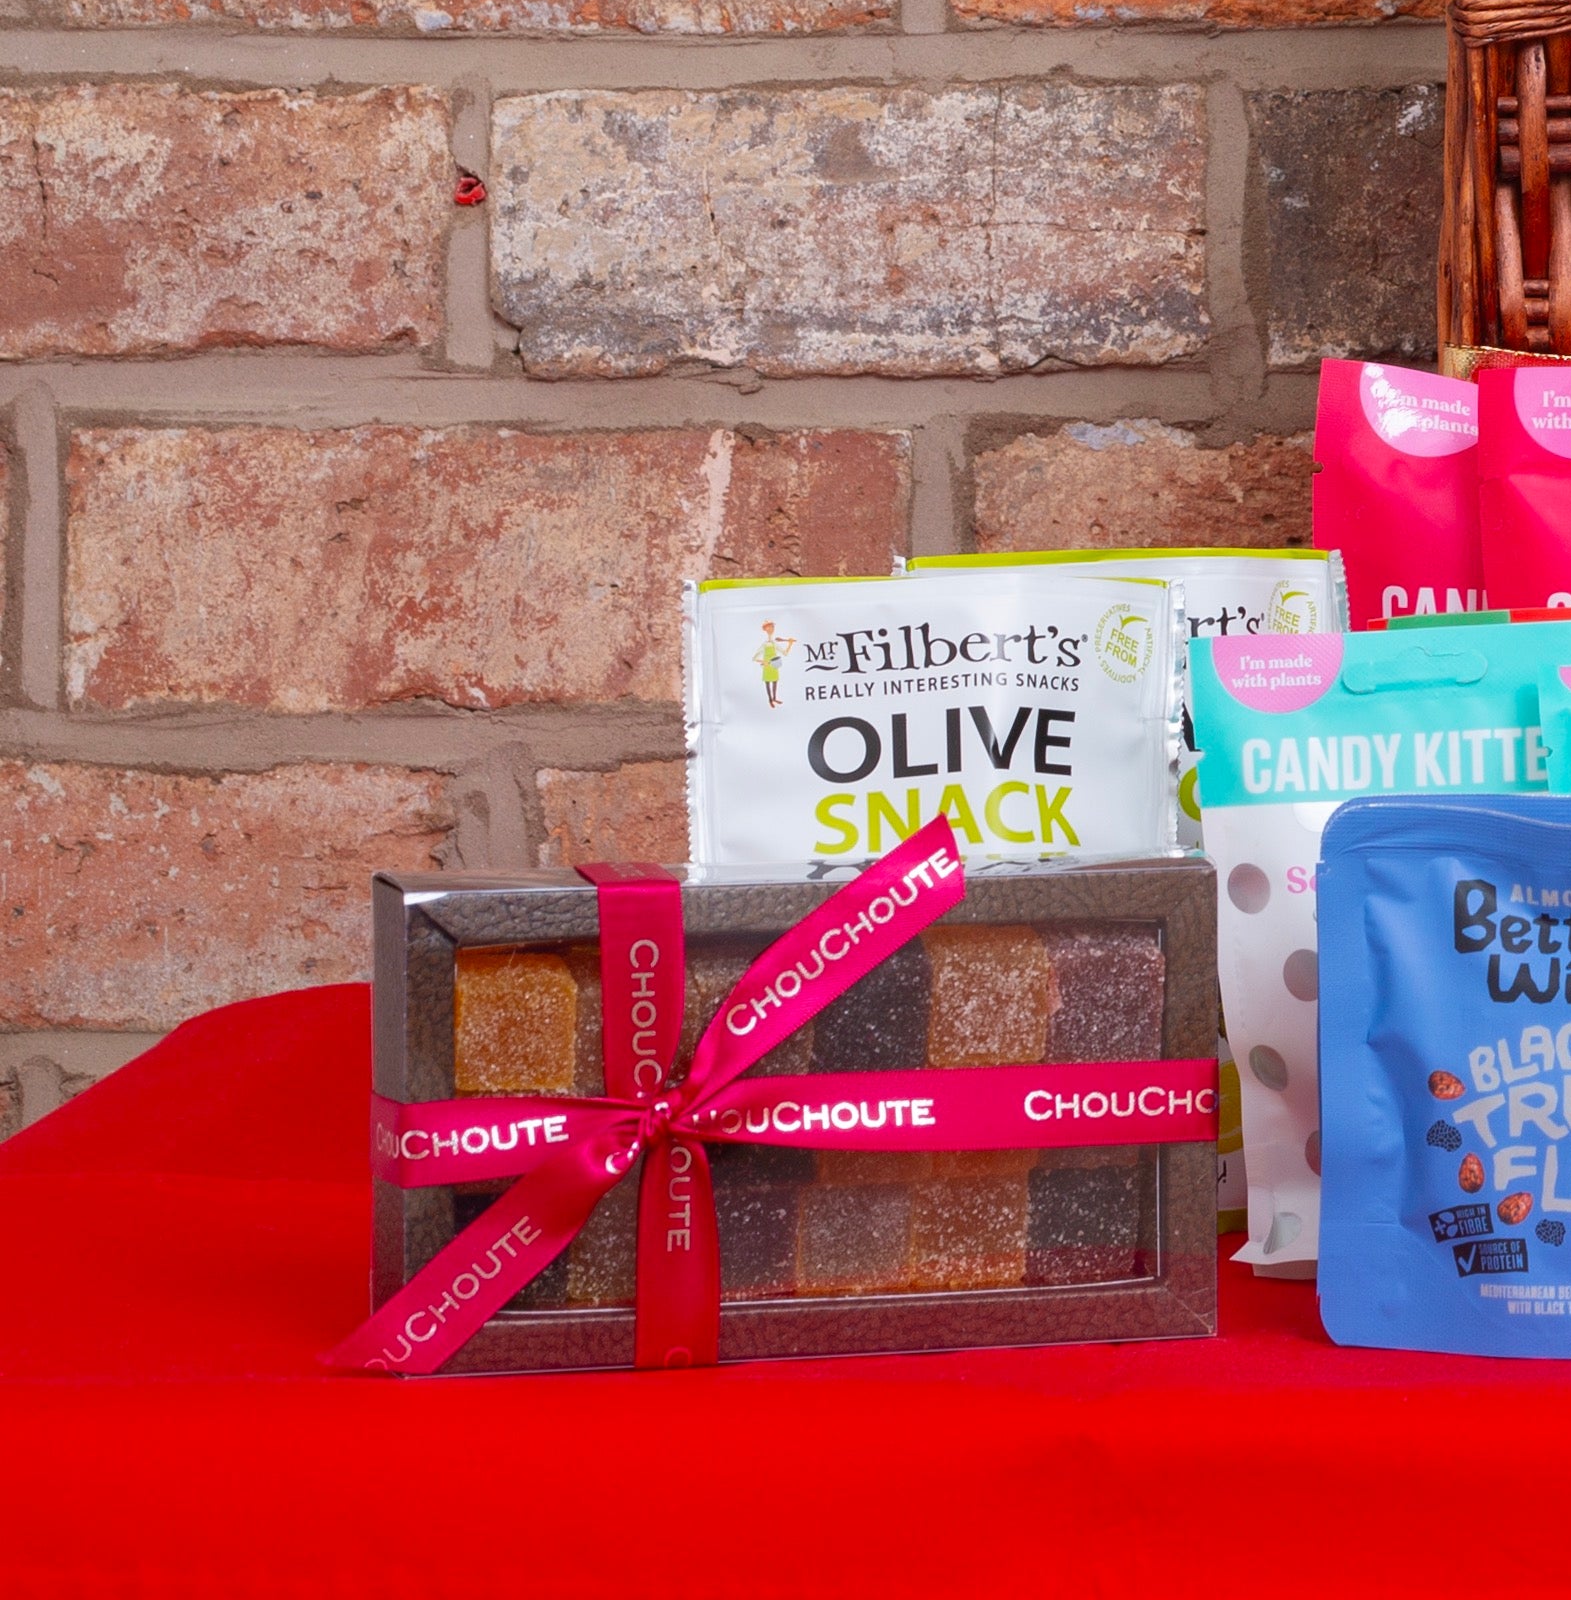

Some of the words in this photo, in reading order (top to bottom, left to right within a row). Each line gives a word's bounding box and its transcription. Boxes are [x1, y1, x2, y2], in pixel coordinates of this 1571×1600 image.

[1542, 390, 1571, 409] I'm
[835, 621, 1082, 676] Filbert's
[1110, 627, 1140, 653] FREE
[1104, 641, 1139, 668] FROM
[1239, 655, 1266, 670] I'm
[1267, 654, 1314, 670] made
[804, 680, 877, 702] REALLY
[883, 671, 1009, 697] INTERESTING
[1015, 672, 1081, 693] SNACKS
[1231, 673, 1268, 690] with
[1269, 672, 1323, 691] plants
[806, 704, 1077, 785] OLIVE
[1240, 731, 1403, 797] CANDY
[813, 779, 1082, 856] SNACK
[724, 845, 964, 1040] CHOUCHOUTE
[1457, 1215, 1489, 1237] FIBRE
[1480, 1252, 1525, 1273] PROTEIN
